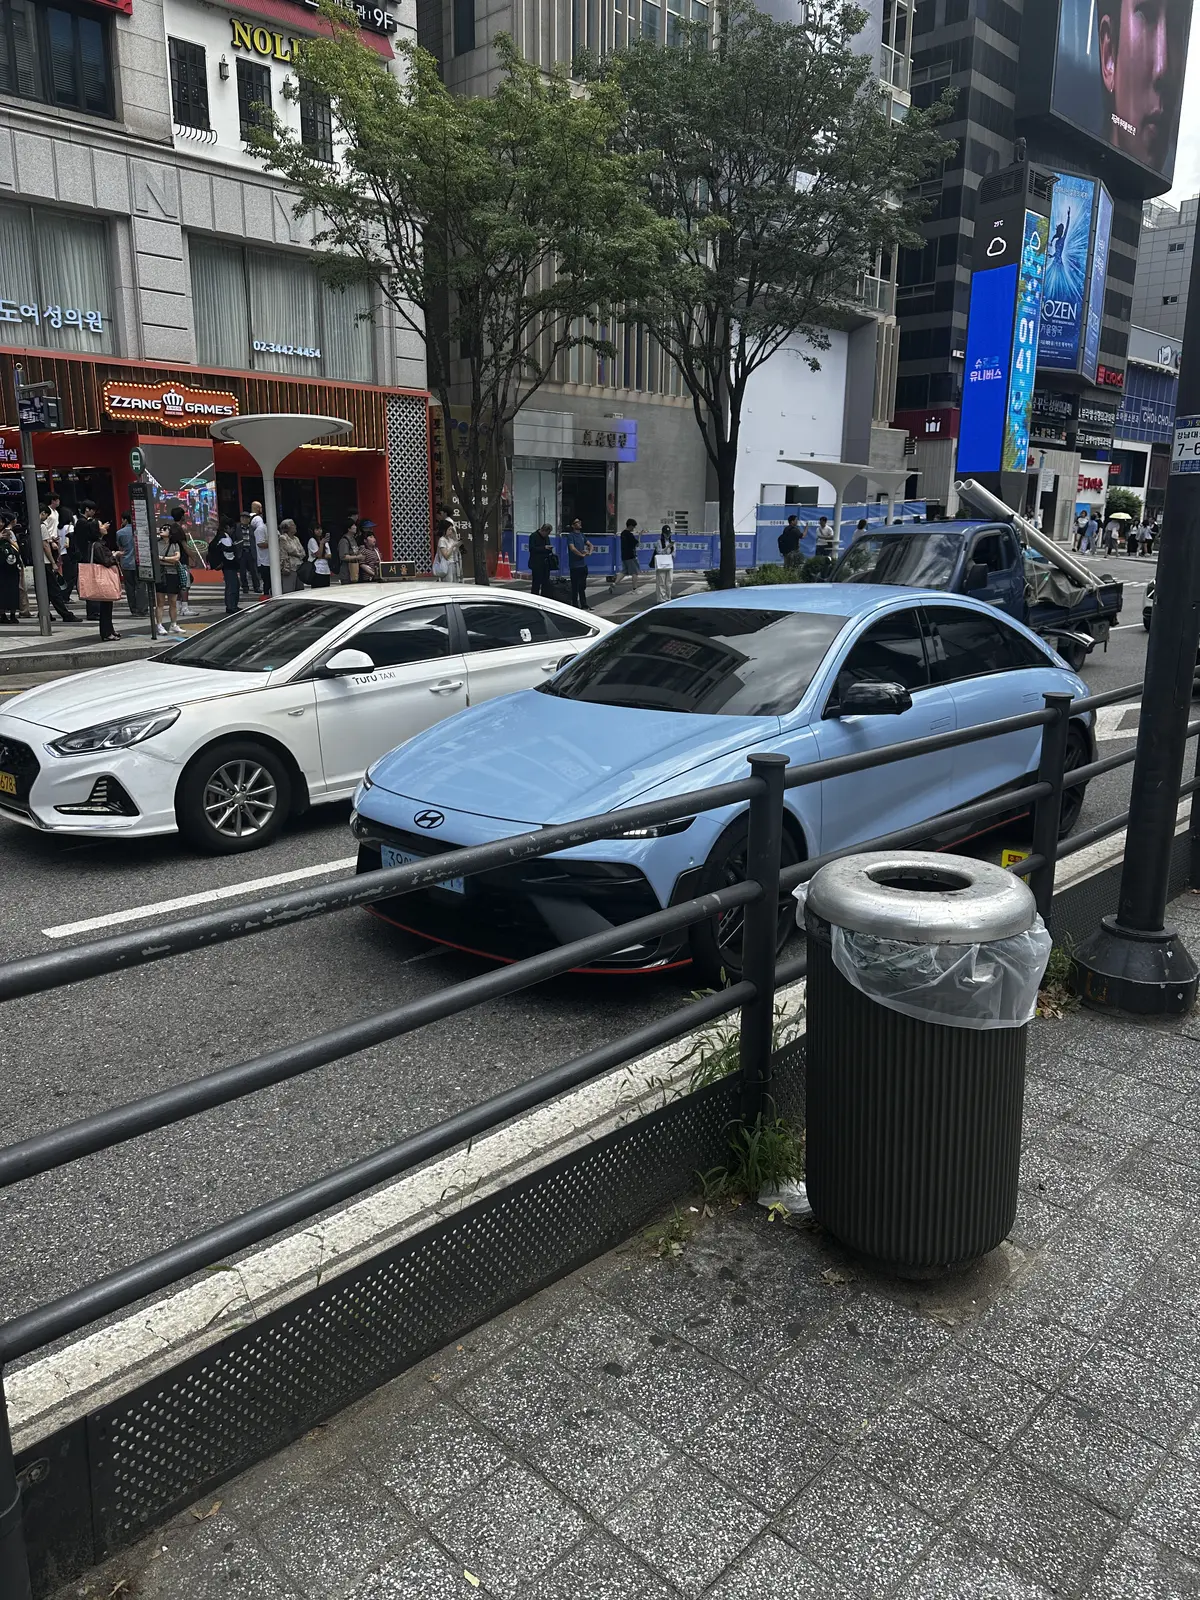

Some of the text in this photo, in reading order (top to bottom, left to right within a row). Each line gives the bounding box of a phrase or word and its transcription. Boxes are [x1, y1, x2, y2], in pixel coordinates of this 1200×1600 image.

[1042, 299, 1077, 321] OZEN
[1019, 317, 1034, 345] 01
[253, 340, 321, 358] 02-3442-4454
[1015, 347, 1031, 374] 41
[970, 369, 1003, 382] 유니버스
[109, 395, 162, 410] ZZANG
[185, 403, 233, 415] GAMES
[1177, 431, 1200, 440] 강남대
[388, 564, 408, 575] 서울
[379, 671, 396, 680] TAXI
